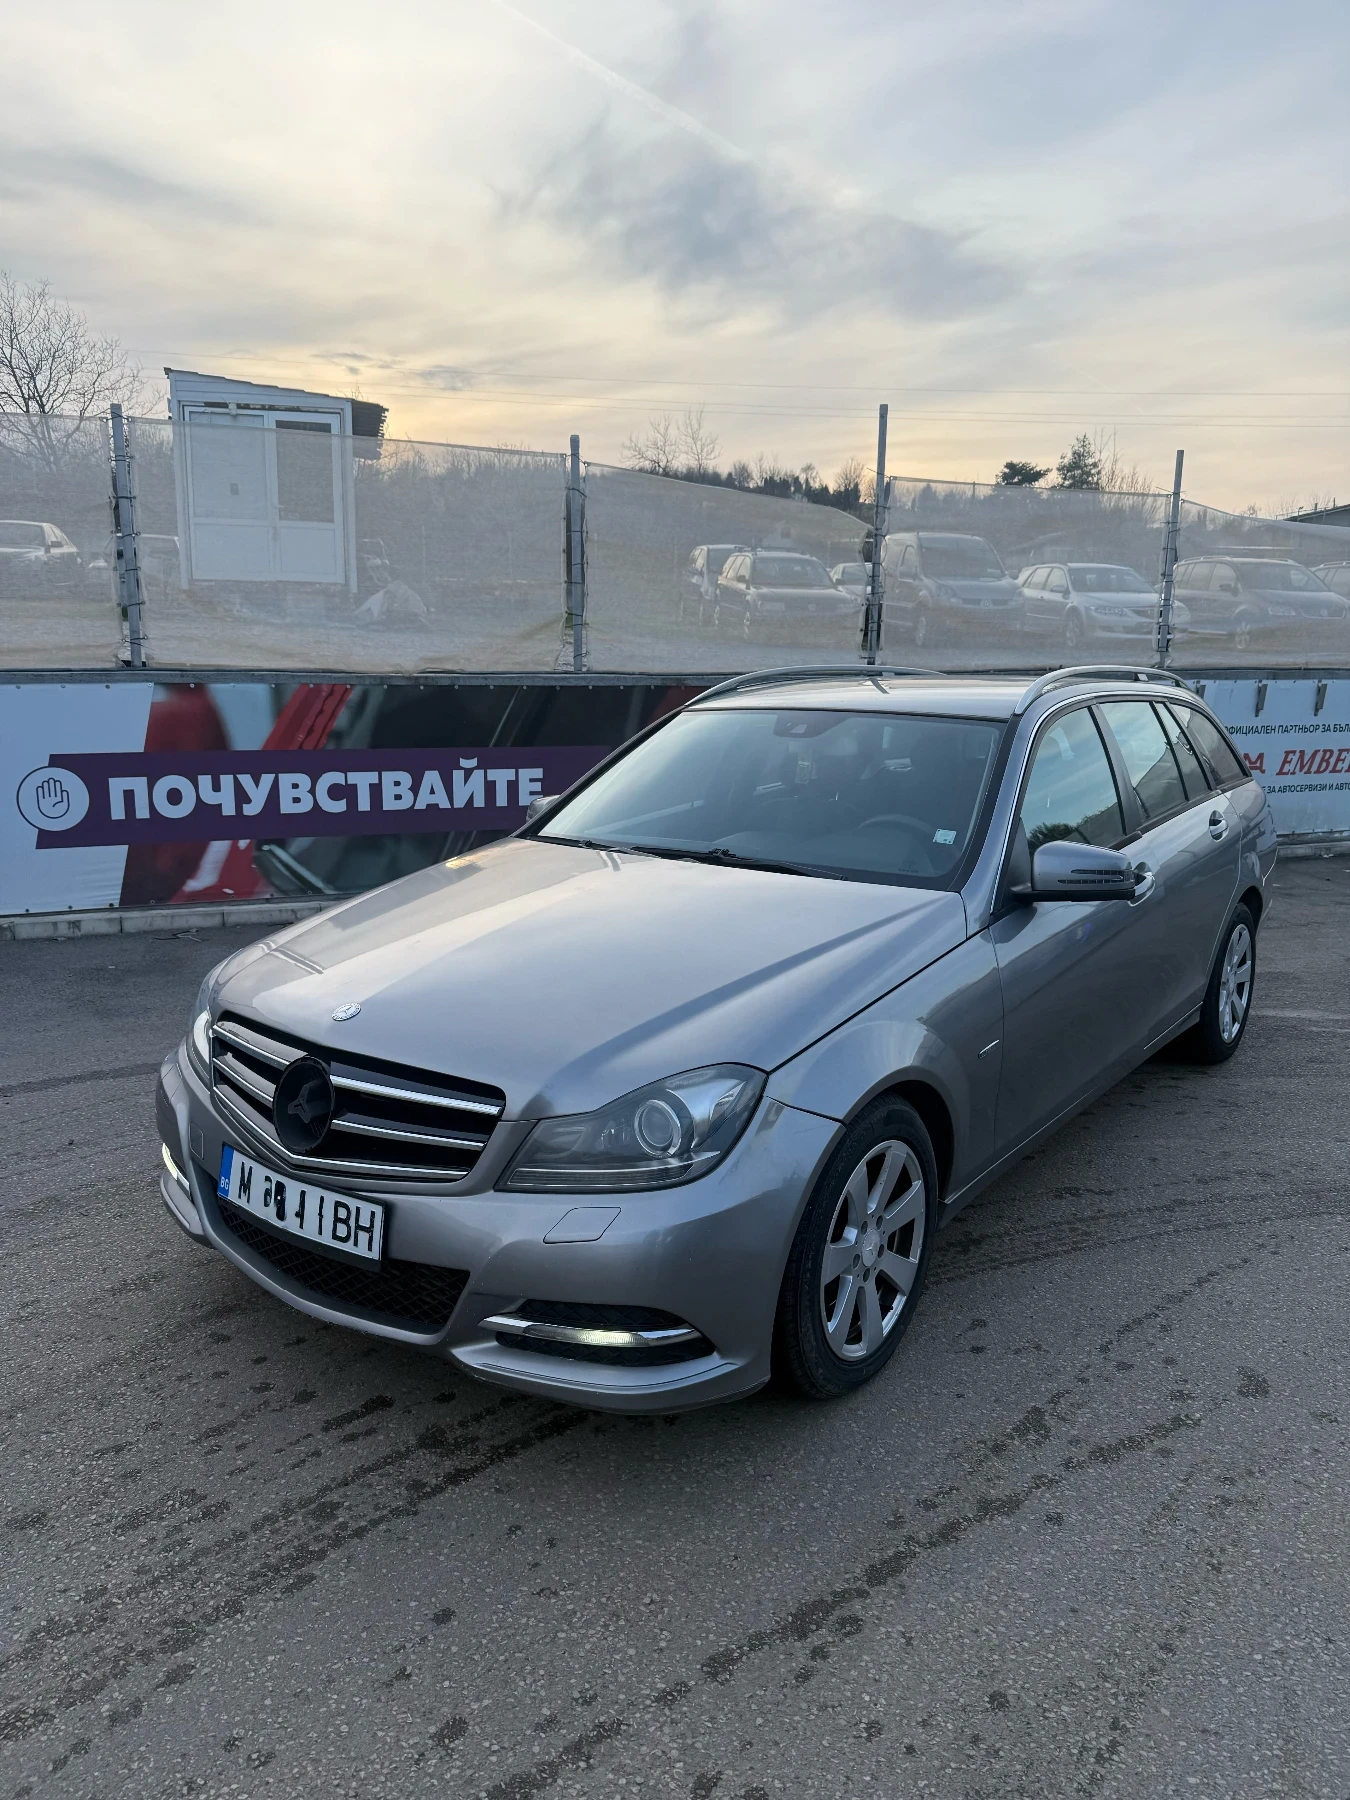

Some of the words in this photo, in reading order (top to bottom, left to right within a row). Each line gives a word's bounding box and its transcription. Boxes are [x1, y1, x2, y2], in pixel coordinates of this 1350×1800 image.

[1278, 724, 1320, 734] ПАРТНЬОР
[1321, 724, 1331, 733] ЗА
[1333, 723, 1350, 733] БЪЛ
[1276, 749, 1350, 776] EMBE
[109, 757, 544, 820] ПОЧУВСТВАЙТЕ
[1267, 786, 1276, 794] ЗА
[1277, 783, 1327, 793] АВТОСЕРВИЗИ
[220, 1176, 230, 1191] BG
